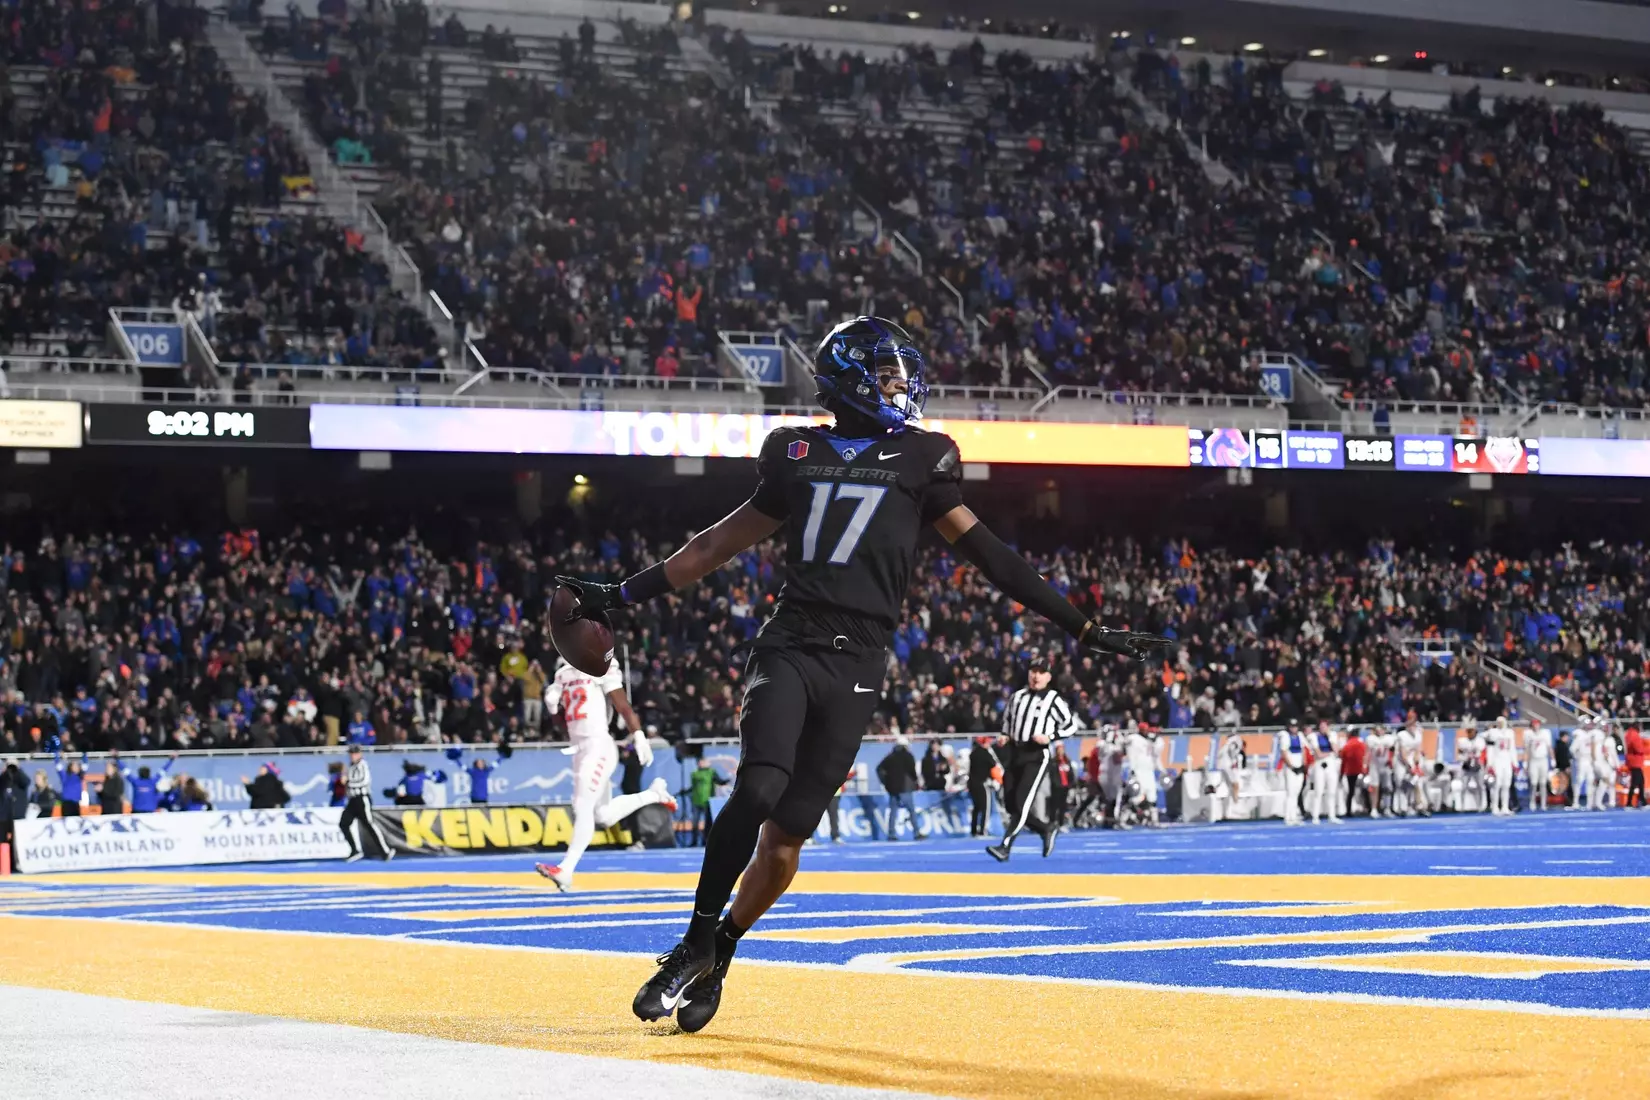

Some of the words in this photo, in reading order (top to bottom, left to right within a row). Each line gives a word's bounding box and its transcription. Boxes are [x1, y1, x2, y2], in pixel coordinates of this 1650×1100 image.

[131, 334, 170, 355] 106
[1260, 373, 1281, 391] 08
[148, 411, 209, 435] 9:02
[214, 412, 254, 436] PM
[603, 411, 786, 457] TOUCH
[1455, 443, 1478, 464] 14
[796, 465, 846, 476] BOISE
[849, 467, 899, 481] STATE
[802, 482, 889, 565] 17
[453, 770, 509, 795] Be
[873, 806, 973, 838] WORL
[25, 838, 175, 861] MOUNTAINLAND
[203, 831, 345, 848] MOUNTAINLAND
